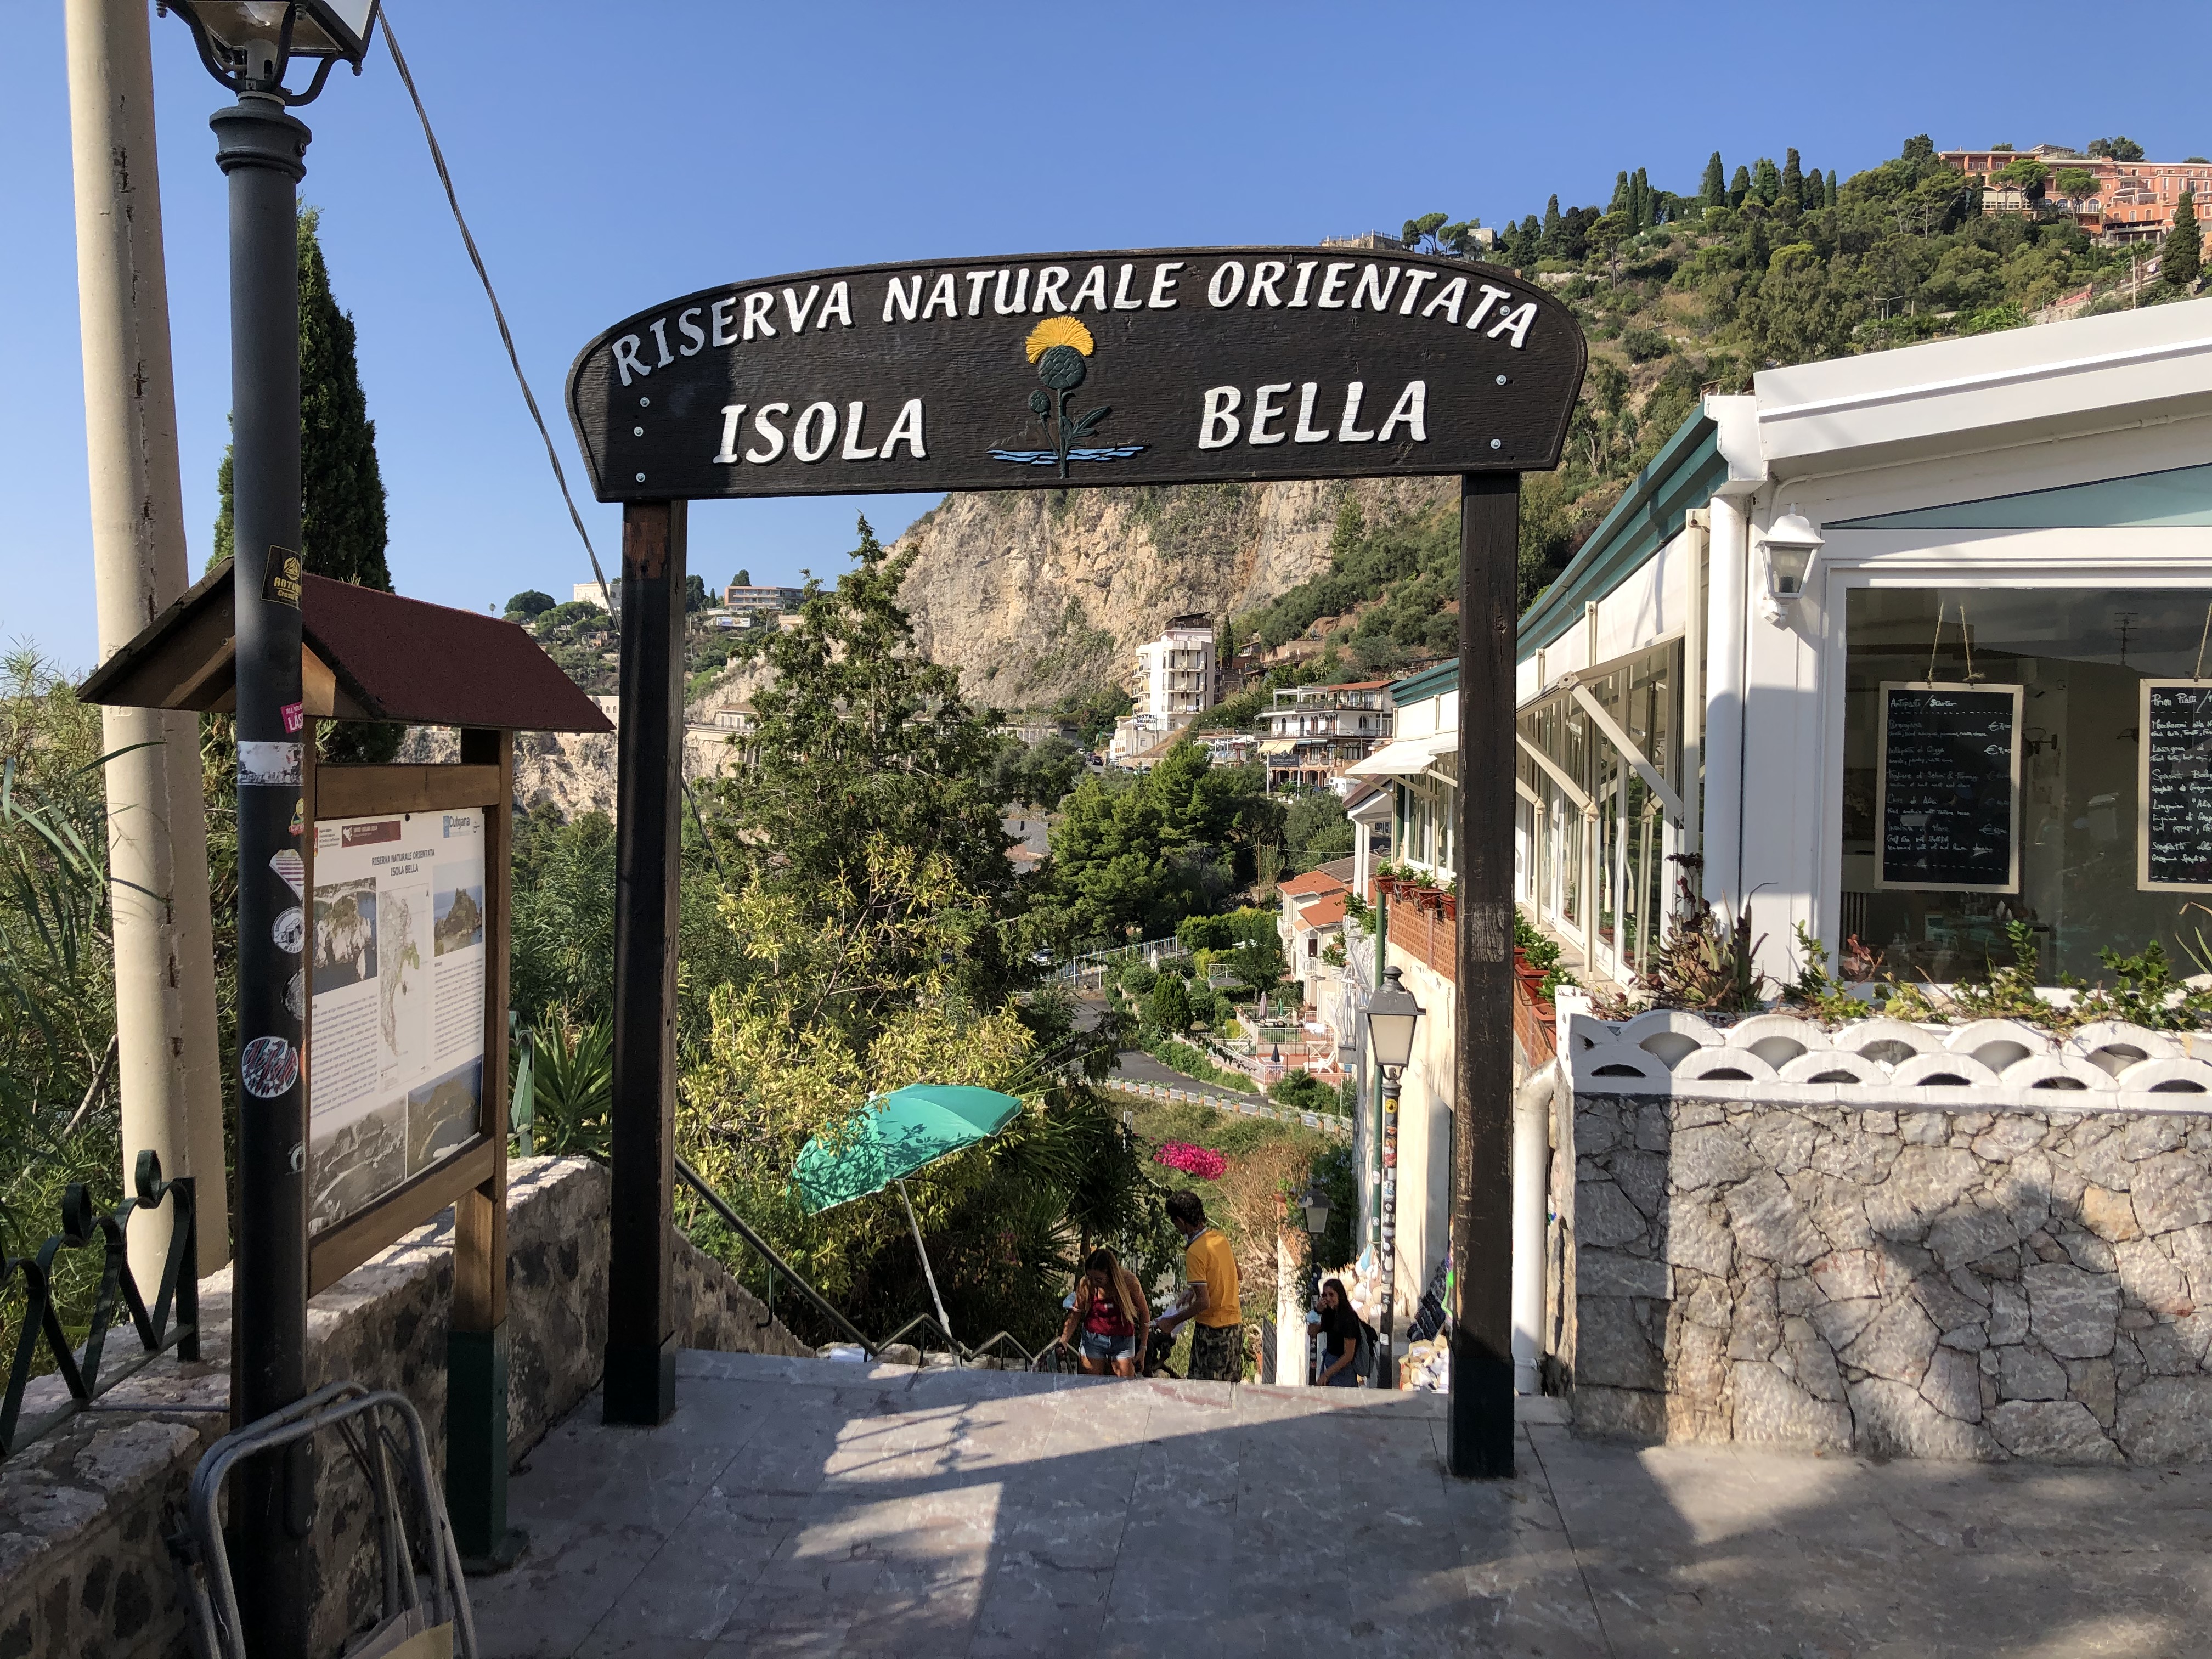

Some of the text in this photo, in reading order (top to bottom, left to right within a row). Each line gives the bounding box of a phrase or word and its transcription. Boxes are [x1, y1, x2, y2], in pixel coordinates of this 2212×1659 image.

[612, 261, 1539, 386] RISERVA NATURALE ORIENTATA
[713, 380, 1427, 465] ISOLA BELLA
[1891, 698, 1921, 710] Antipasti
[1929, 699, 1957, 707] Starter
[2175, 692, 2197, 704] Piatti
[450, 816, 470, 830] Cutgana
[371, 849, 435, 866] RISERVA NATURALE ORIENTATA
[390, 864, 419, 876] ISOLA BELLA
